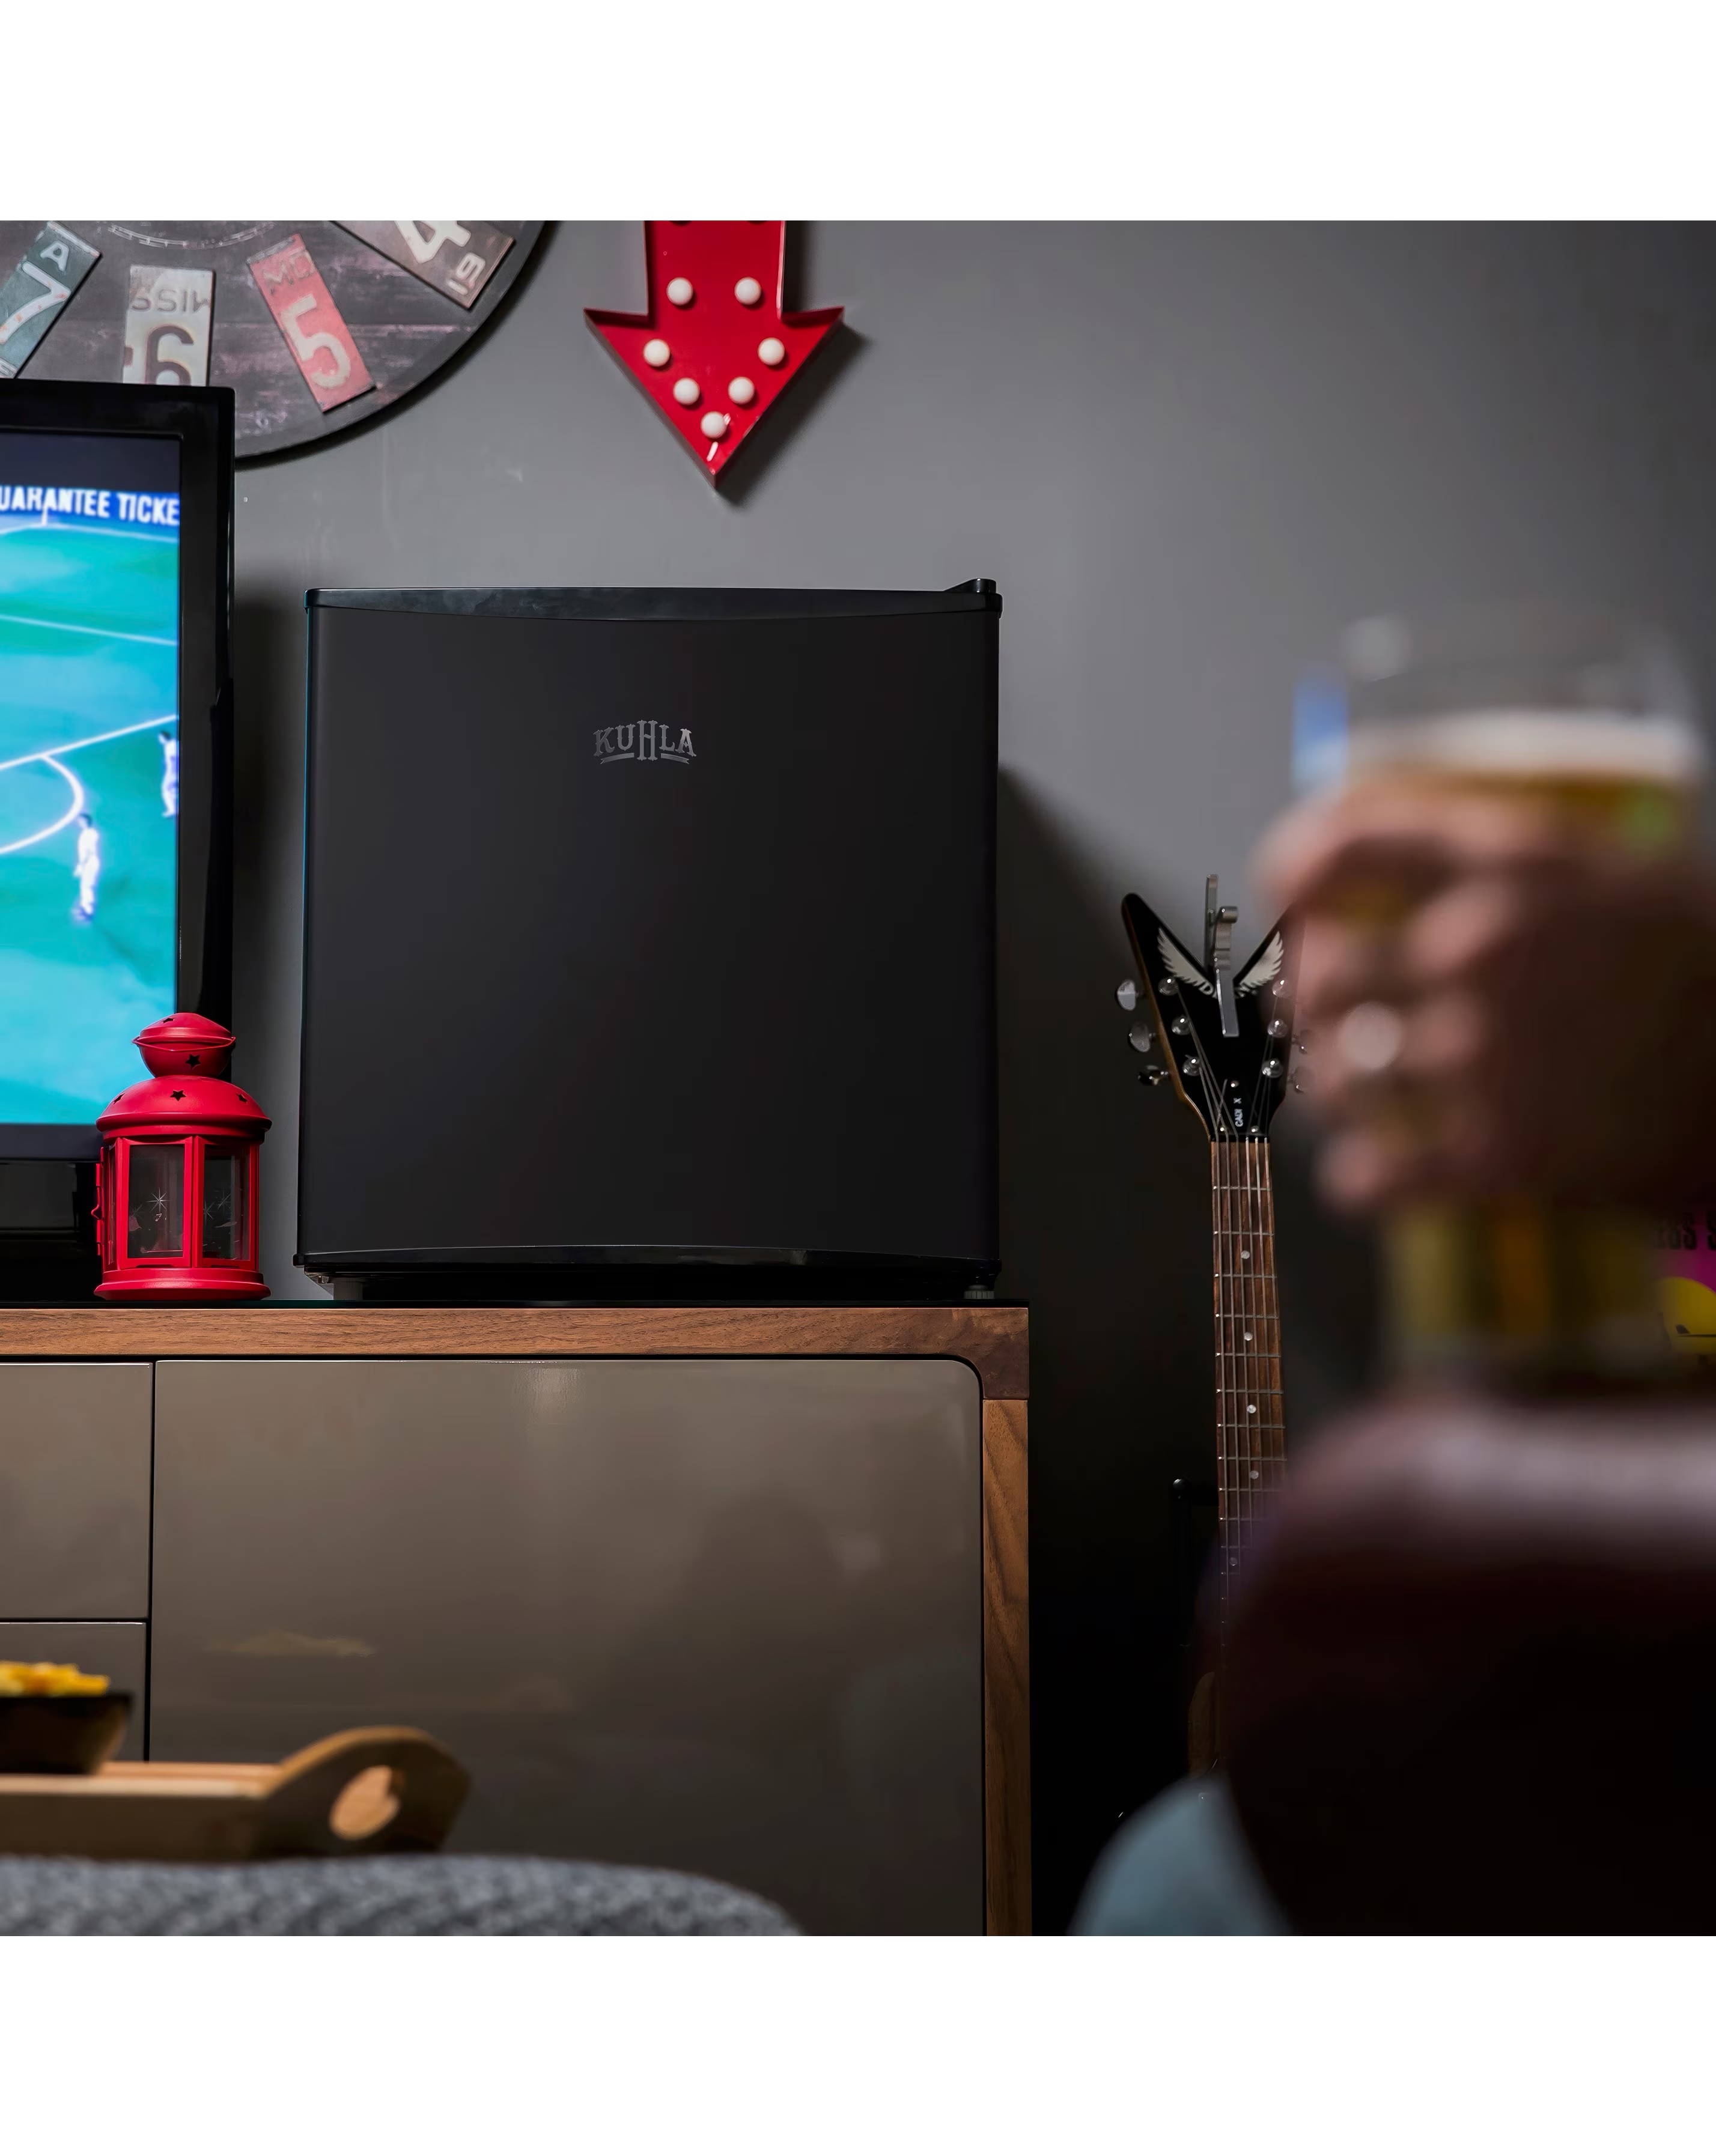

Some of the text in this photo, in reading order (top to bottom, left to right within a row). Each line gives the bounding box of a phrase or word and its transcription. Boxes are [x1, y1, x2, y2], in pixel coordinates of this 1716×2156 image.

[40, 241, 70, 272] A
[0, 261, 72, 344] 7
[281, 294, 351, 389] 5
[592, 719, 697, 761] KUHLA
